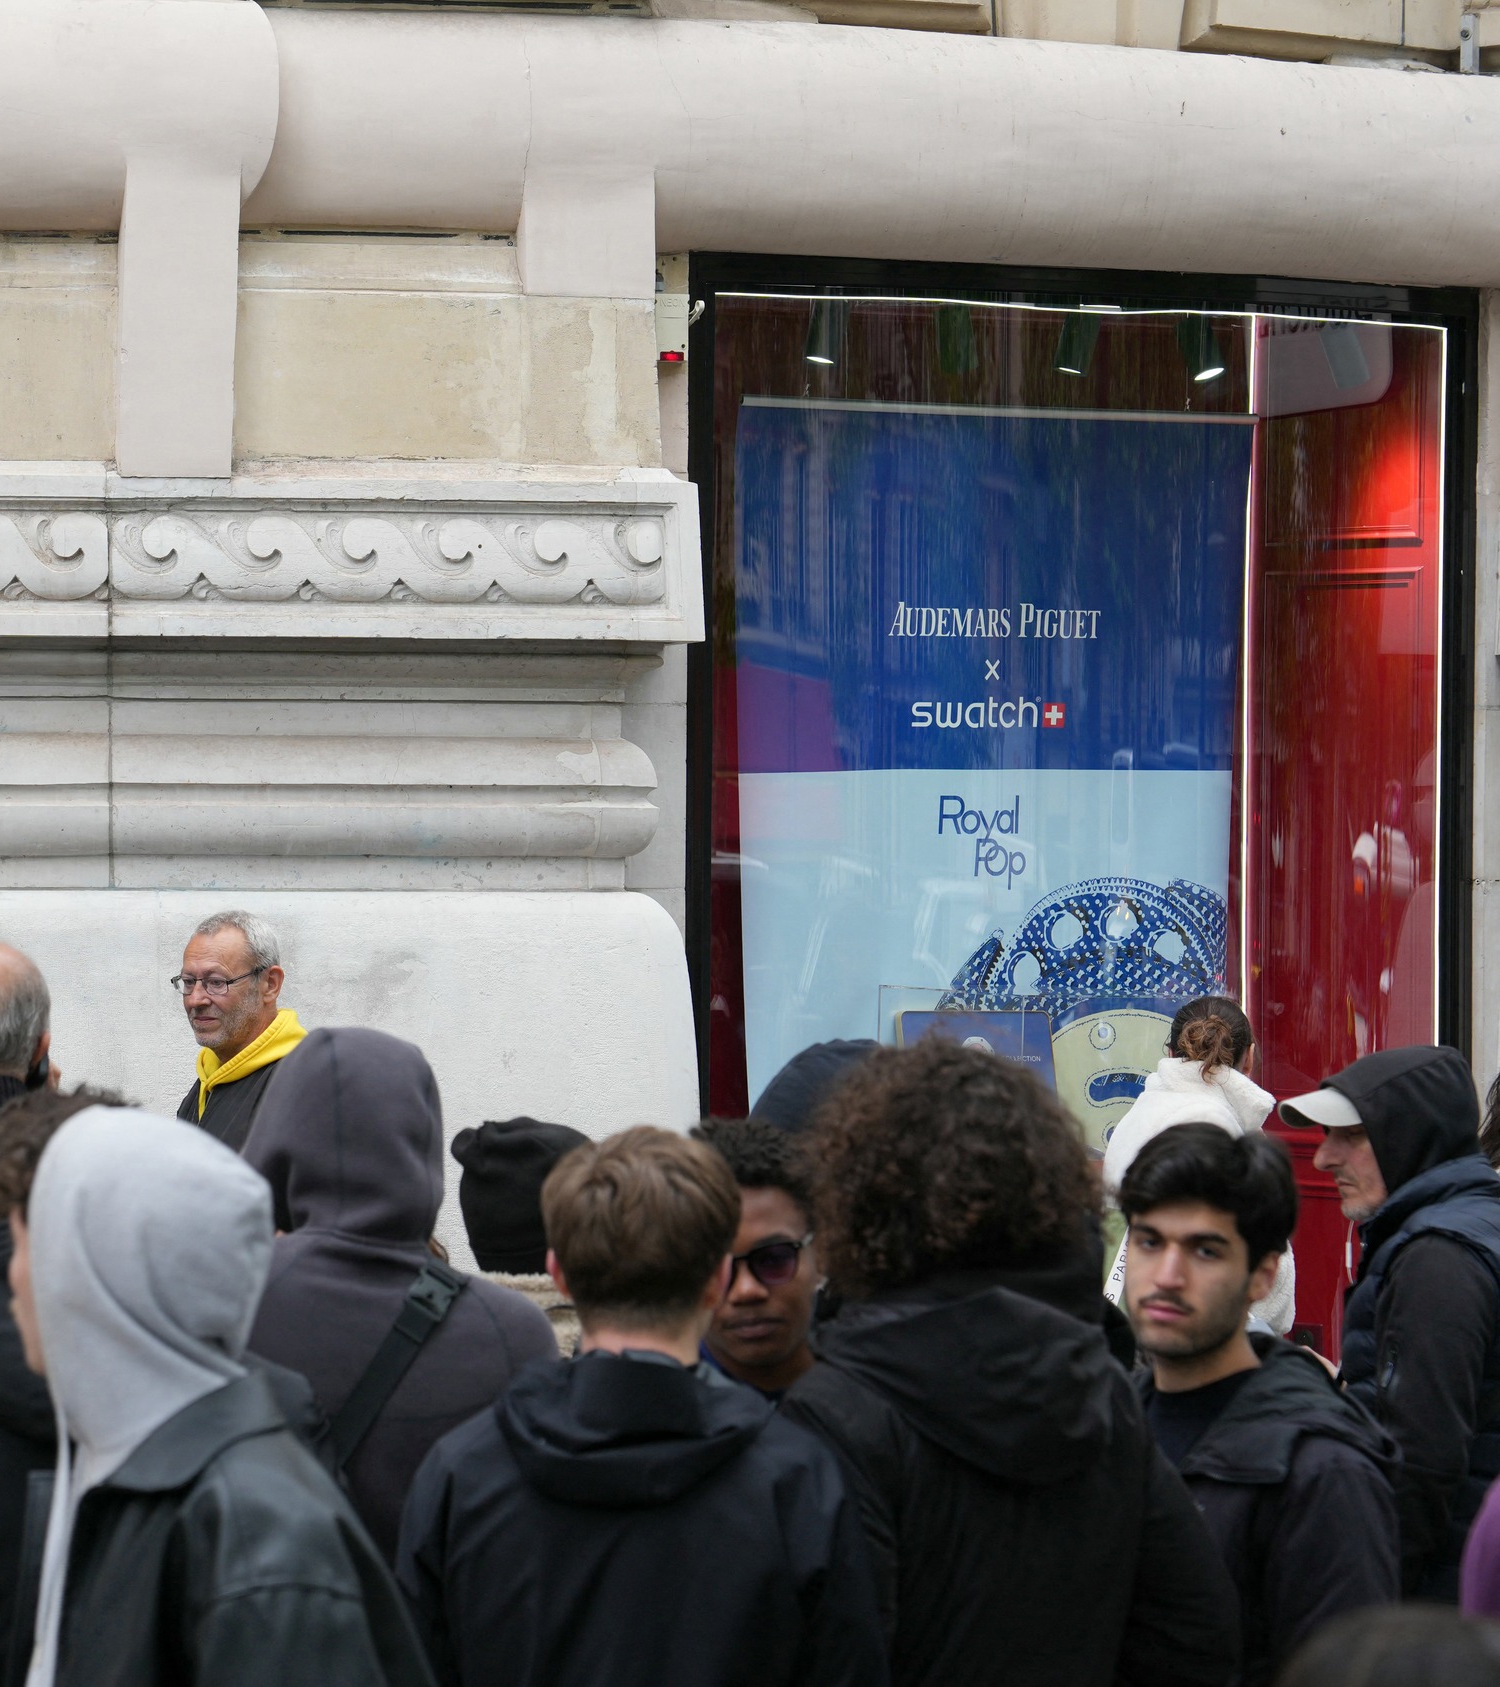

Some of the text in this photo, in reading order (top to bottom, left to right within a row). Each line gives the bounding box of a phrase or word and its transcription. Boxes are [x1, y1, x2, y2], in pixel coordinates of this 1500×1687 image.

[888, 601, 1101, 639] AUDEMARS PIGUET
[938, 795, 1020, 847] Royal
